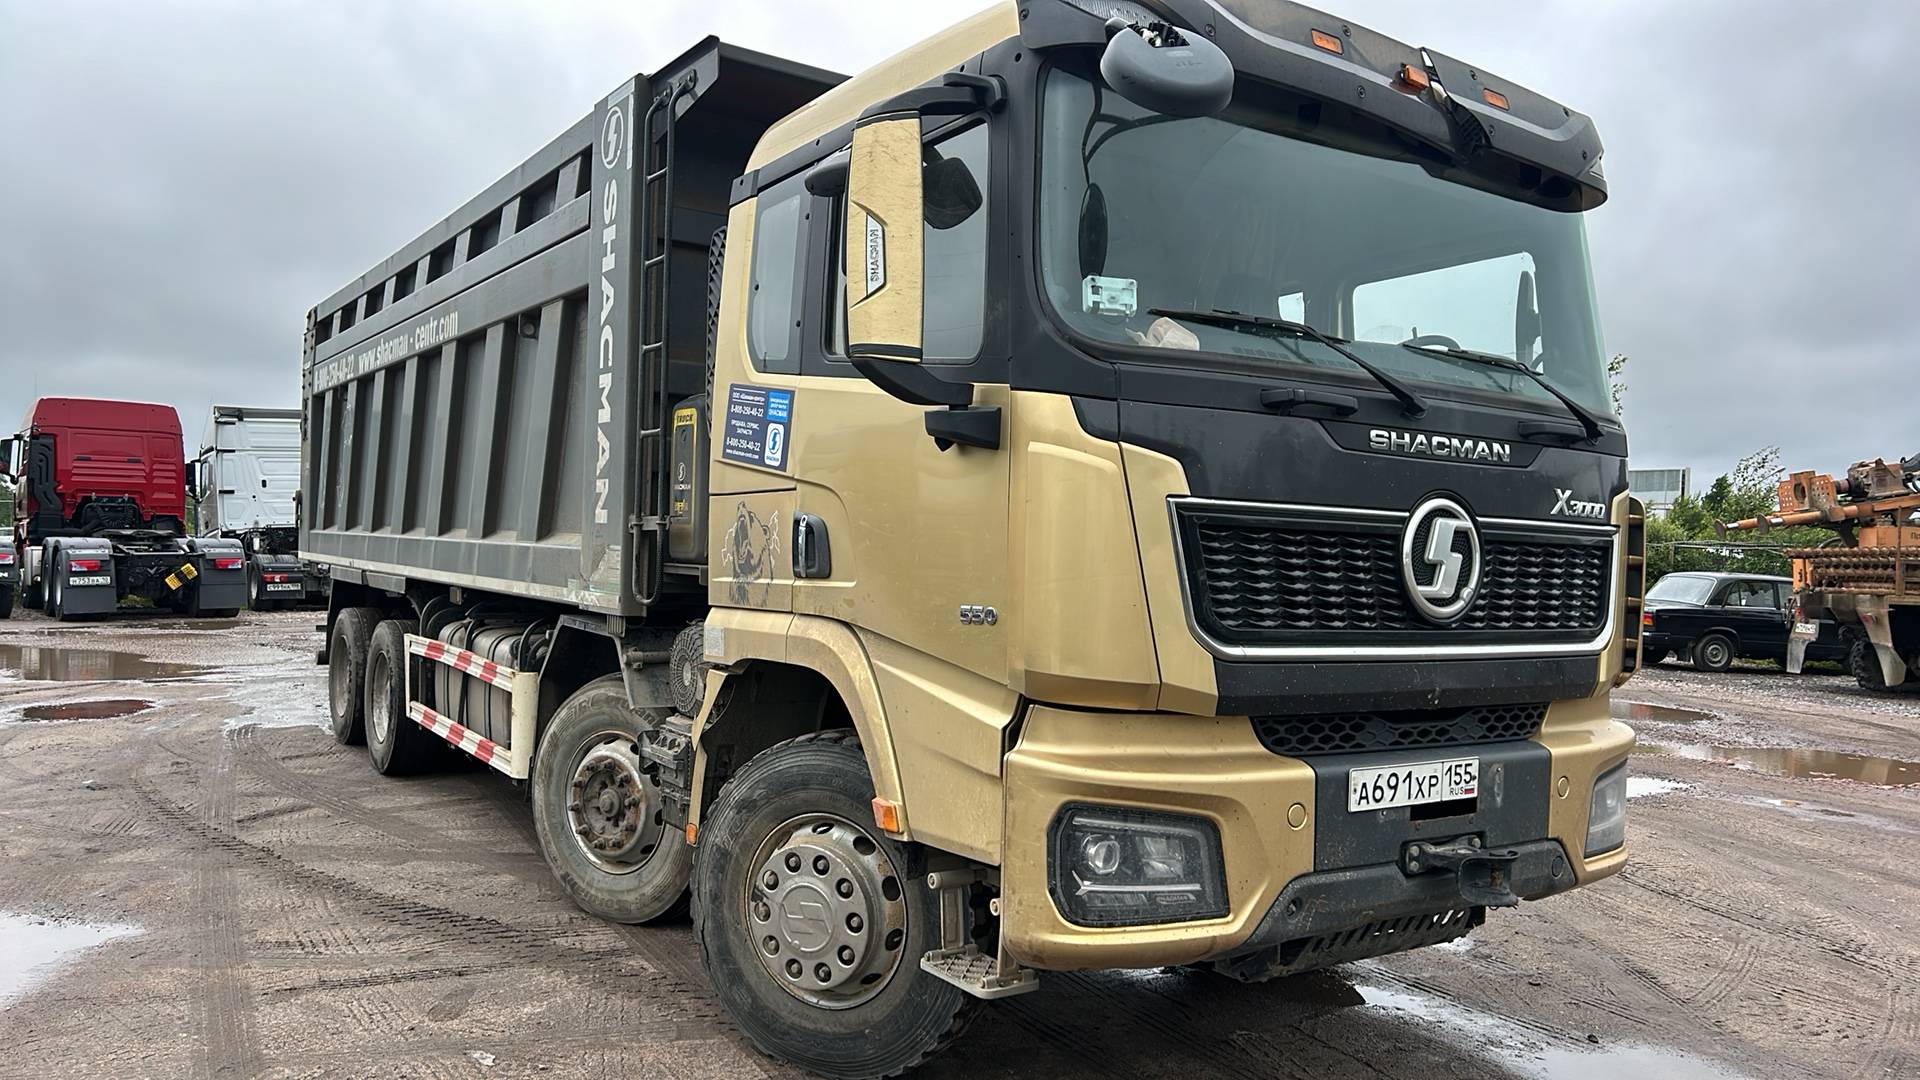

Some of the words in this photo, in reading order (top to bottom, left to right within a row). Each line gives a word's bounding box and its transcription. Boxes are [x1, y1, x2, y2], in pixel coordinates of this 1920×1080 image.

[870, 229, 880, 282] SHACMAN
[595, 178, 618, 525] SHACMAN
[1369, 428, 1511, 462] SHACMAN
[960, 605, 997, 626] 550
[1445, 763, 1474, 787] 155
[1449, 786, 1464, 796] RUS
